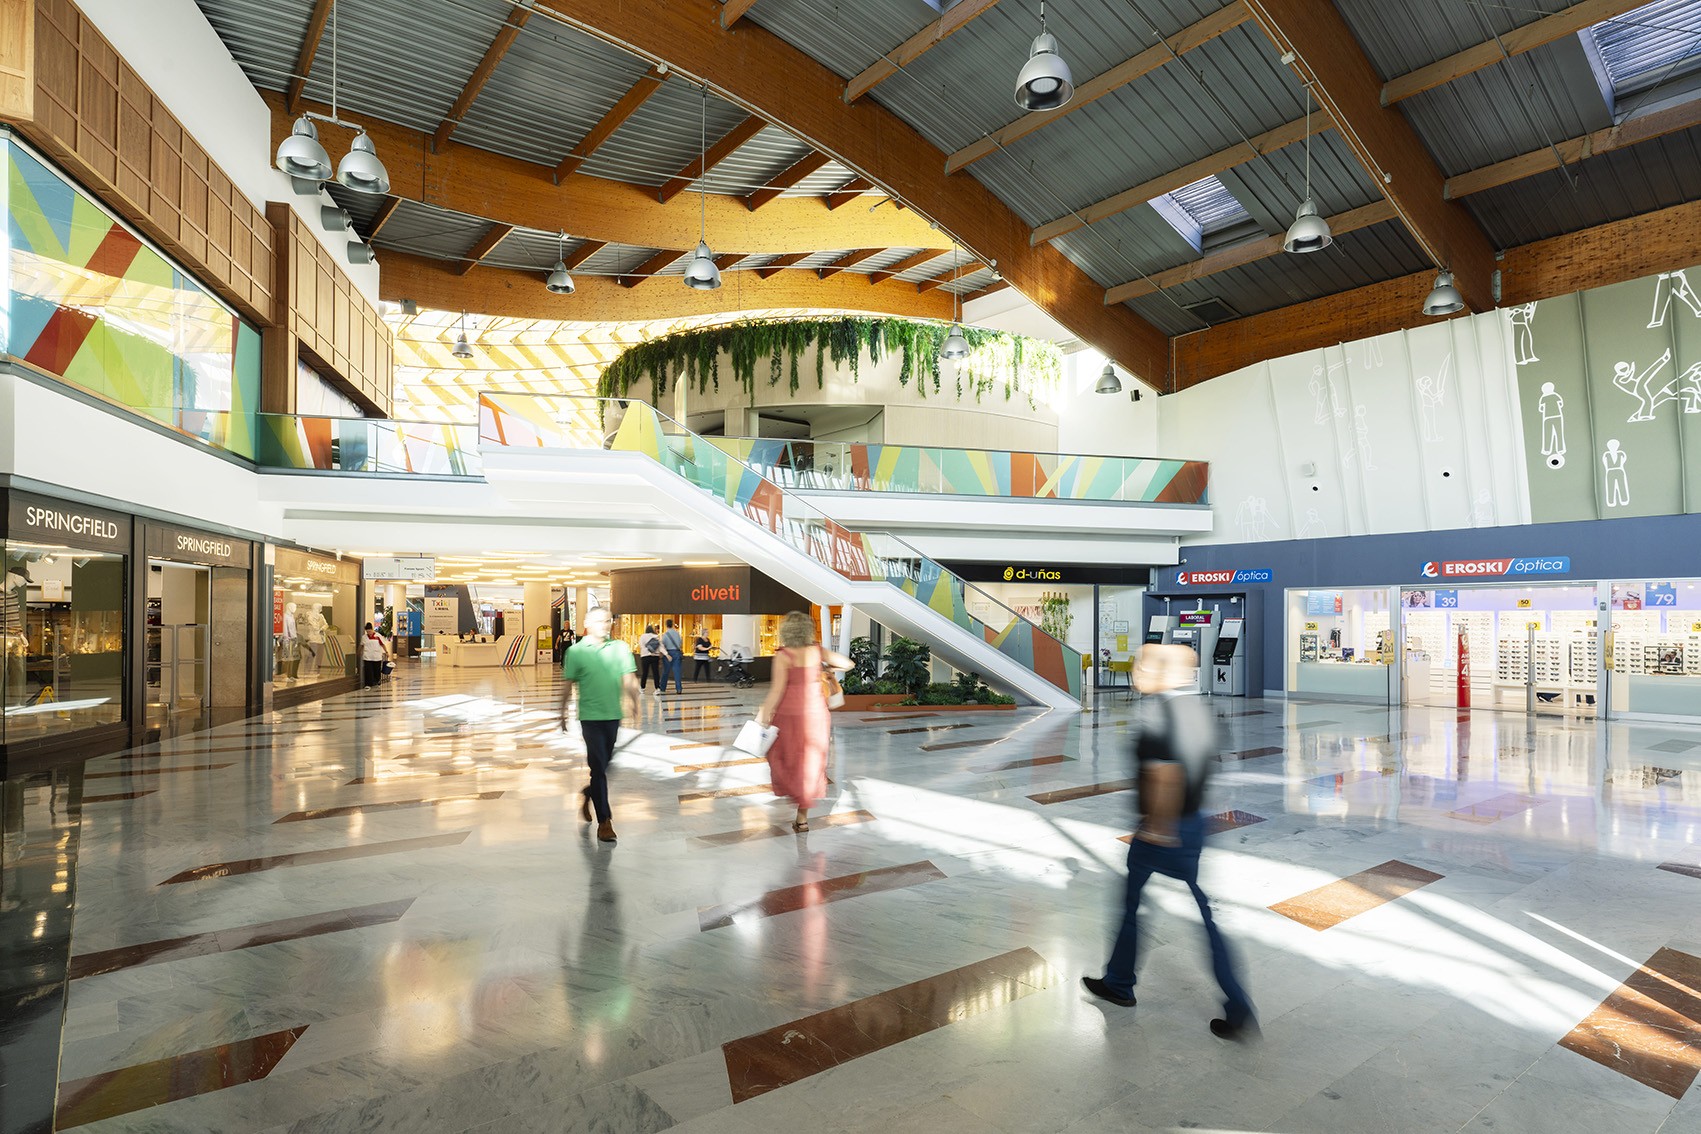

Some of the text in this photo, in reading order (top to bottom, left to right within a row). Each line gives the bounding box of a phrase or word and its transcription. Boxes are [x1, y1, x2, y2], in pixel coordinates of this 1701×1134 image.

[26, 506, 118, 539] SPRINGFIELD
[177, 535, 231, 557] SPRINGFIELD
[1016, 568, 1061, 580] d-uñas
[1445, 559, 1563, 574] EROSKI óptica
[1191, 570, 1269, 583] EROSKI óptica
[691, 584, 740, 601] cilveti
